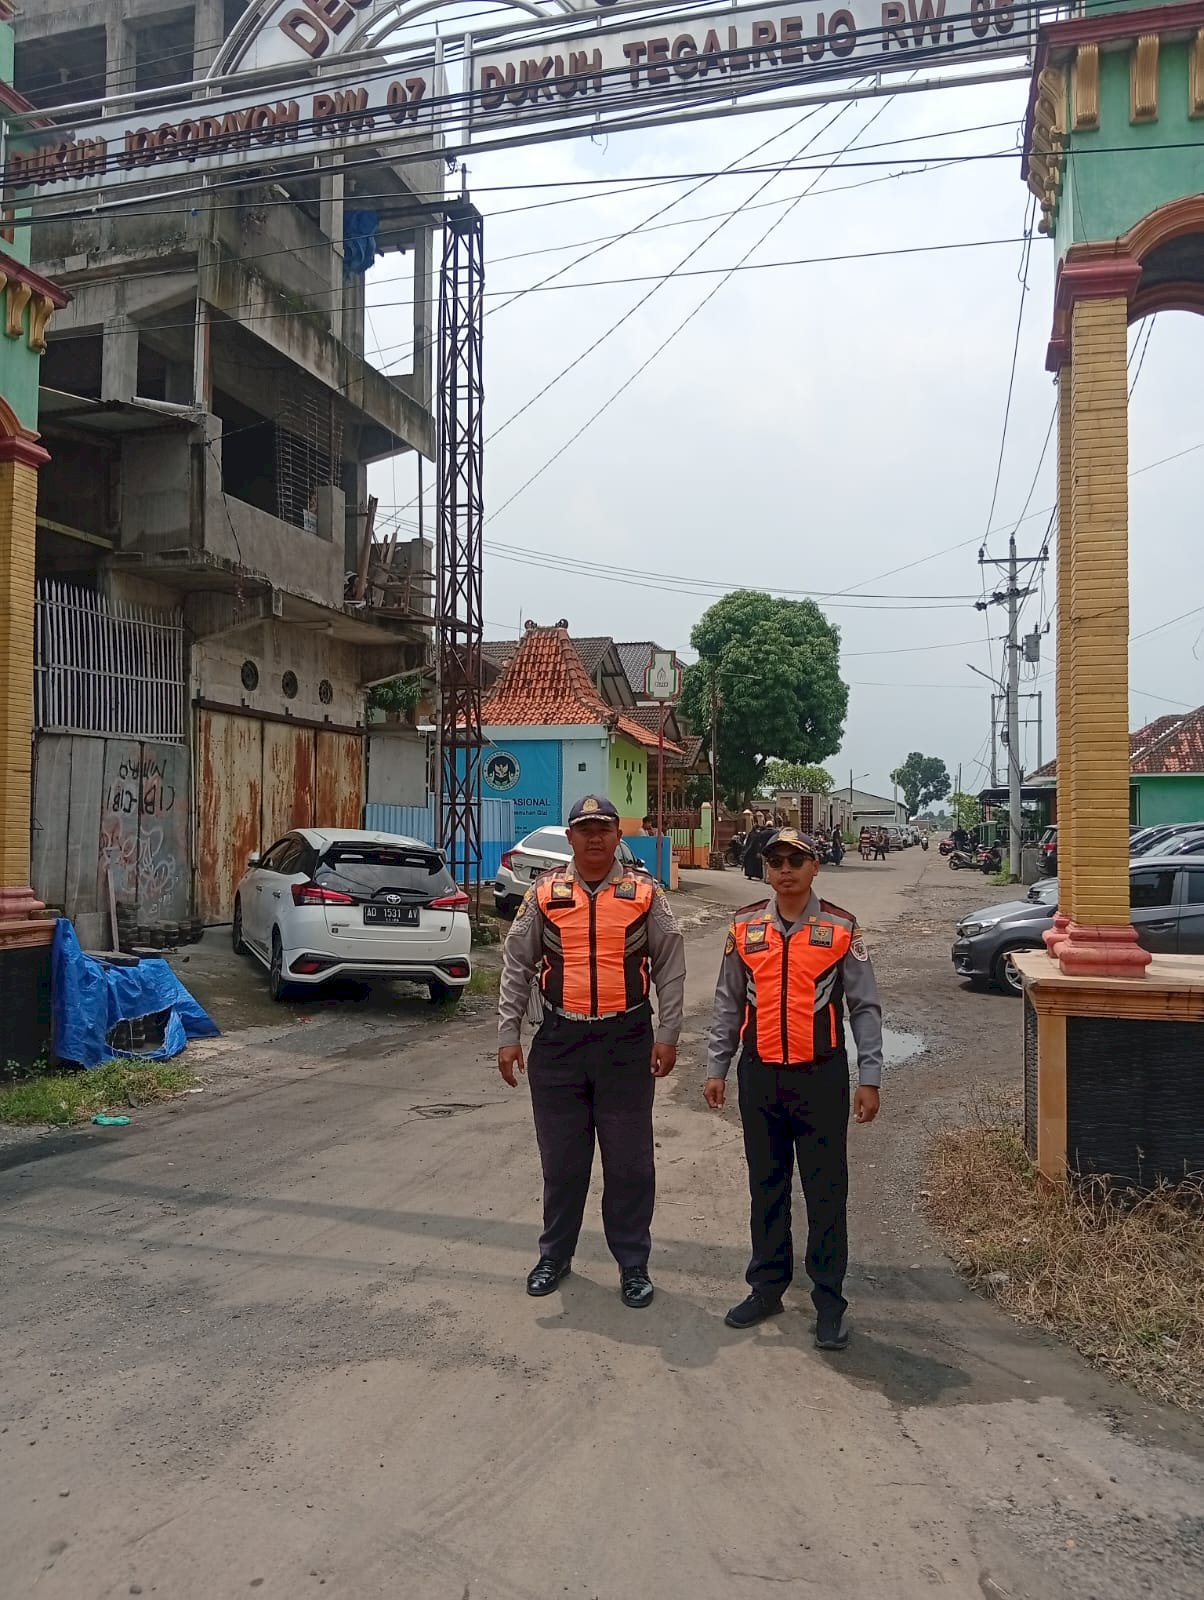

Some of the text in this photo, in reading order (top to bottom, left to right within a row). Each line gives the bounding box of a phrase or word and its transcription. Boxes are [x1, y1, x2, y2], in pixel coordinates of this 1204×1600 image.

[480, 48, 603, 110] DUKUH
[622, 8, 857, 89] TEGALREJO
[881, 0, 955, 51] RW.
[312, 87, 375, 137] RW.
[387, 77, 426, 124] 07
[367, 908, 377, 917] AD
[384, 908, 401, 918] 1531
